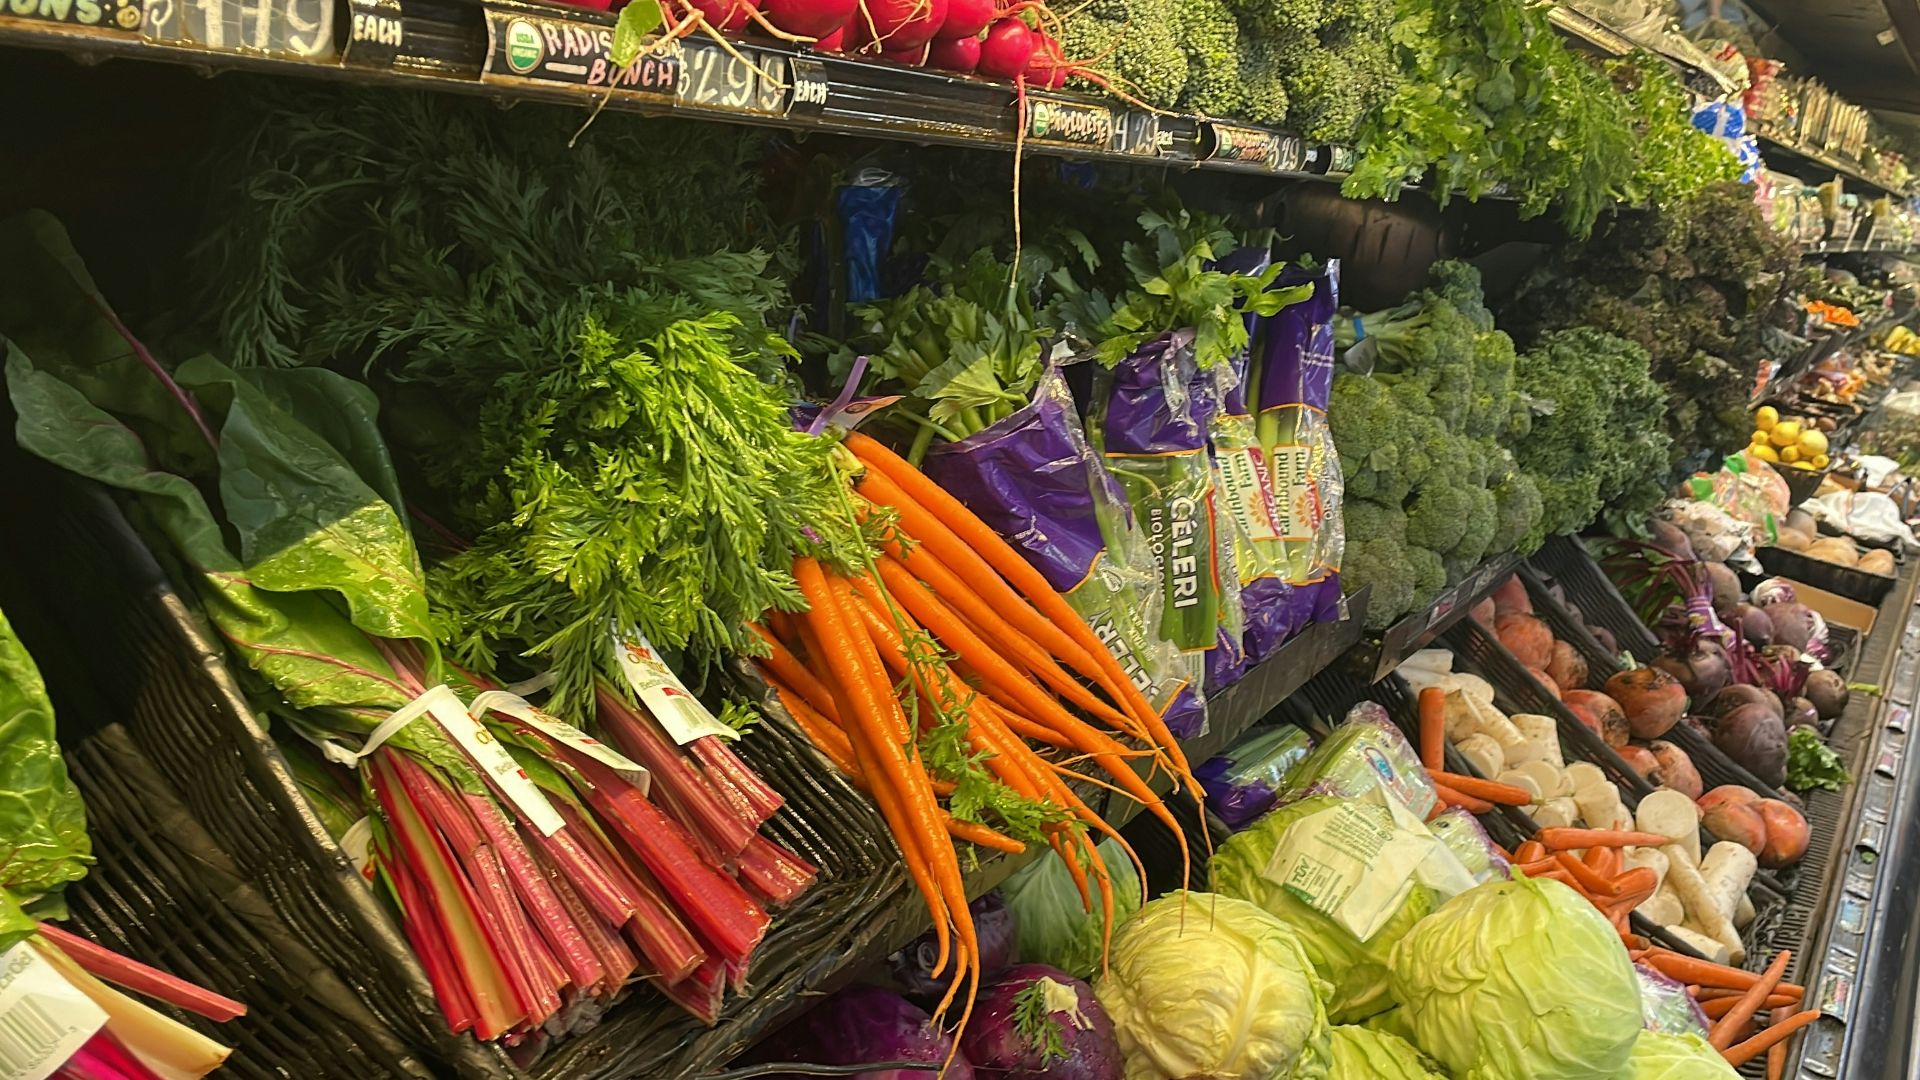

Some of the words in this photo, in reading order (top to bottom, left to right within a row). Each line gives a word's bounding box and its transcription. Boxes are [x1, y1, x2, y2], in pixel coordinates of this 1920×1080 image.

[353, 14, 401, 47] EACH
[795, 79, 828, 104] EACH
[1216, 456, 1251, 537] arthbound
[1234, 453, 1253, 489] Farm
[1252, 454, 1281, 535] ORGANIC
[1274, 452, 1290, 536] Earthbound
[1292, 451, 1306, 486] Farm
[1171, 497, 1199, 608] CÉLERI
[1088, 607, 1161, 700] ELERY
